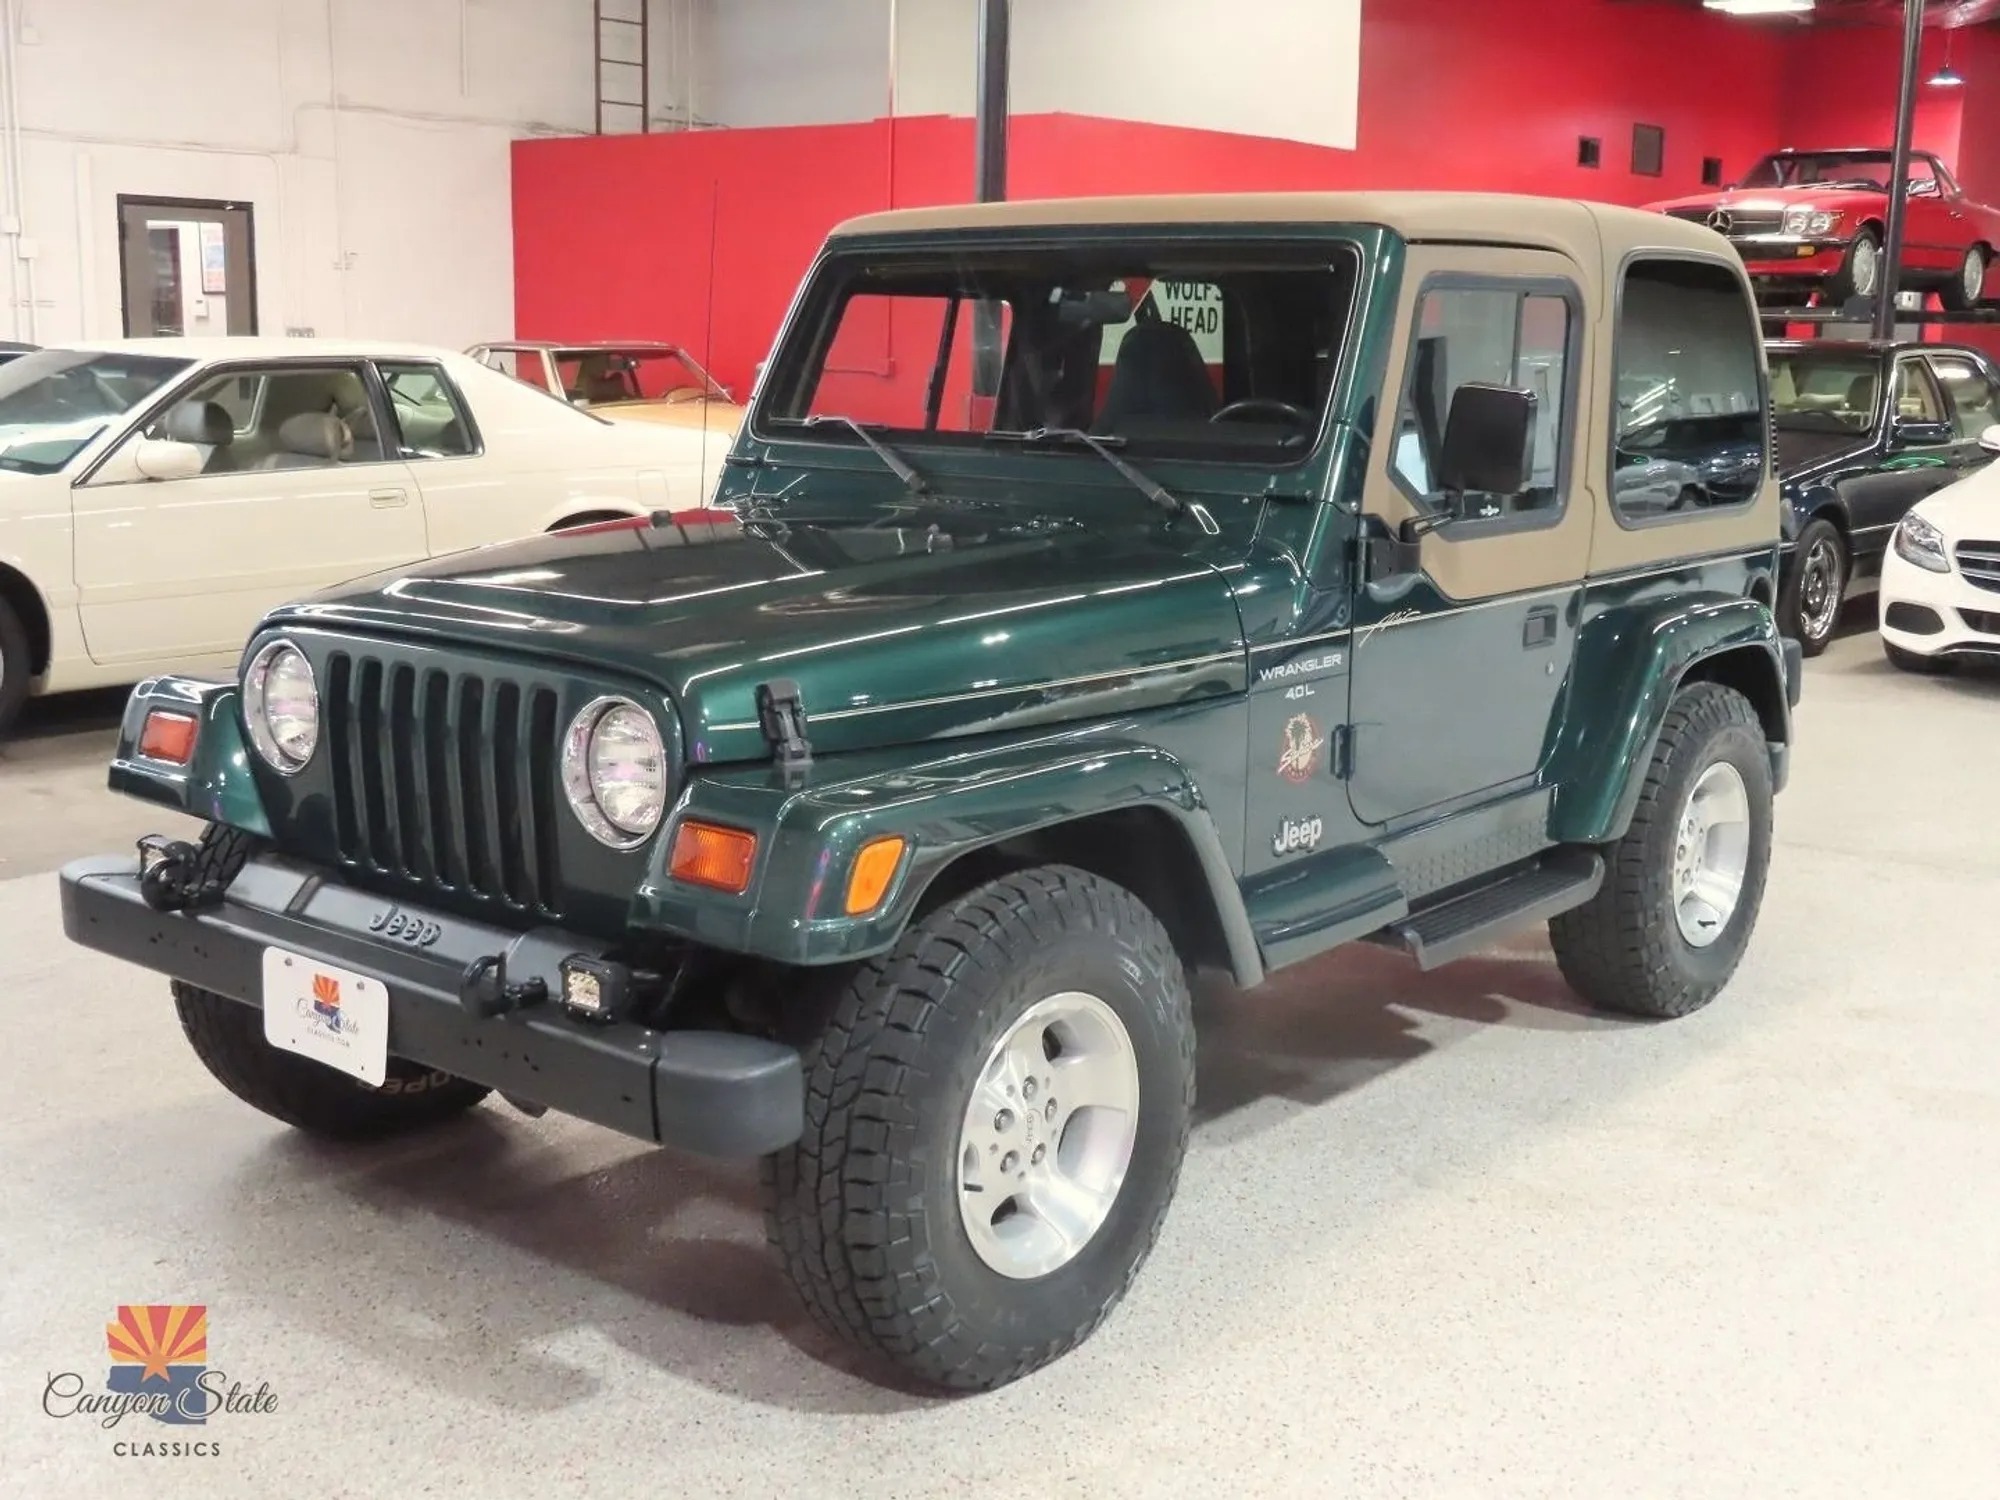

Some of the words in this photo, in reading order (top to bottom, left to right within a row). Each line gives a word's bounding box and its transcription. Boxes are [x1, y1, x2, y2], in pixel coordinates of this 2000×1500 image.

[1170, 306, 1218, 334] HEAD
[1259, 653, 1342, 682] WRANGLER
[1273, 816, 1323, 856] Jeep
[368, 902, 442, 947] Jeep
